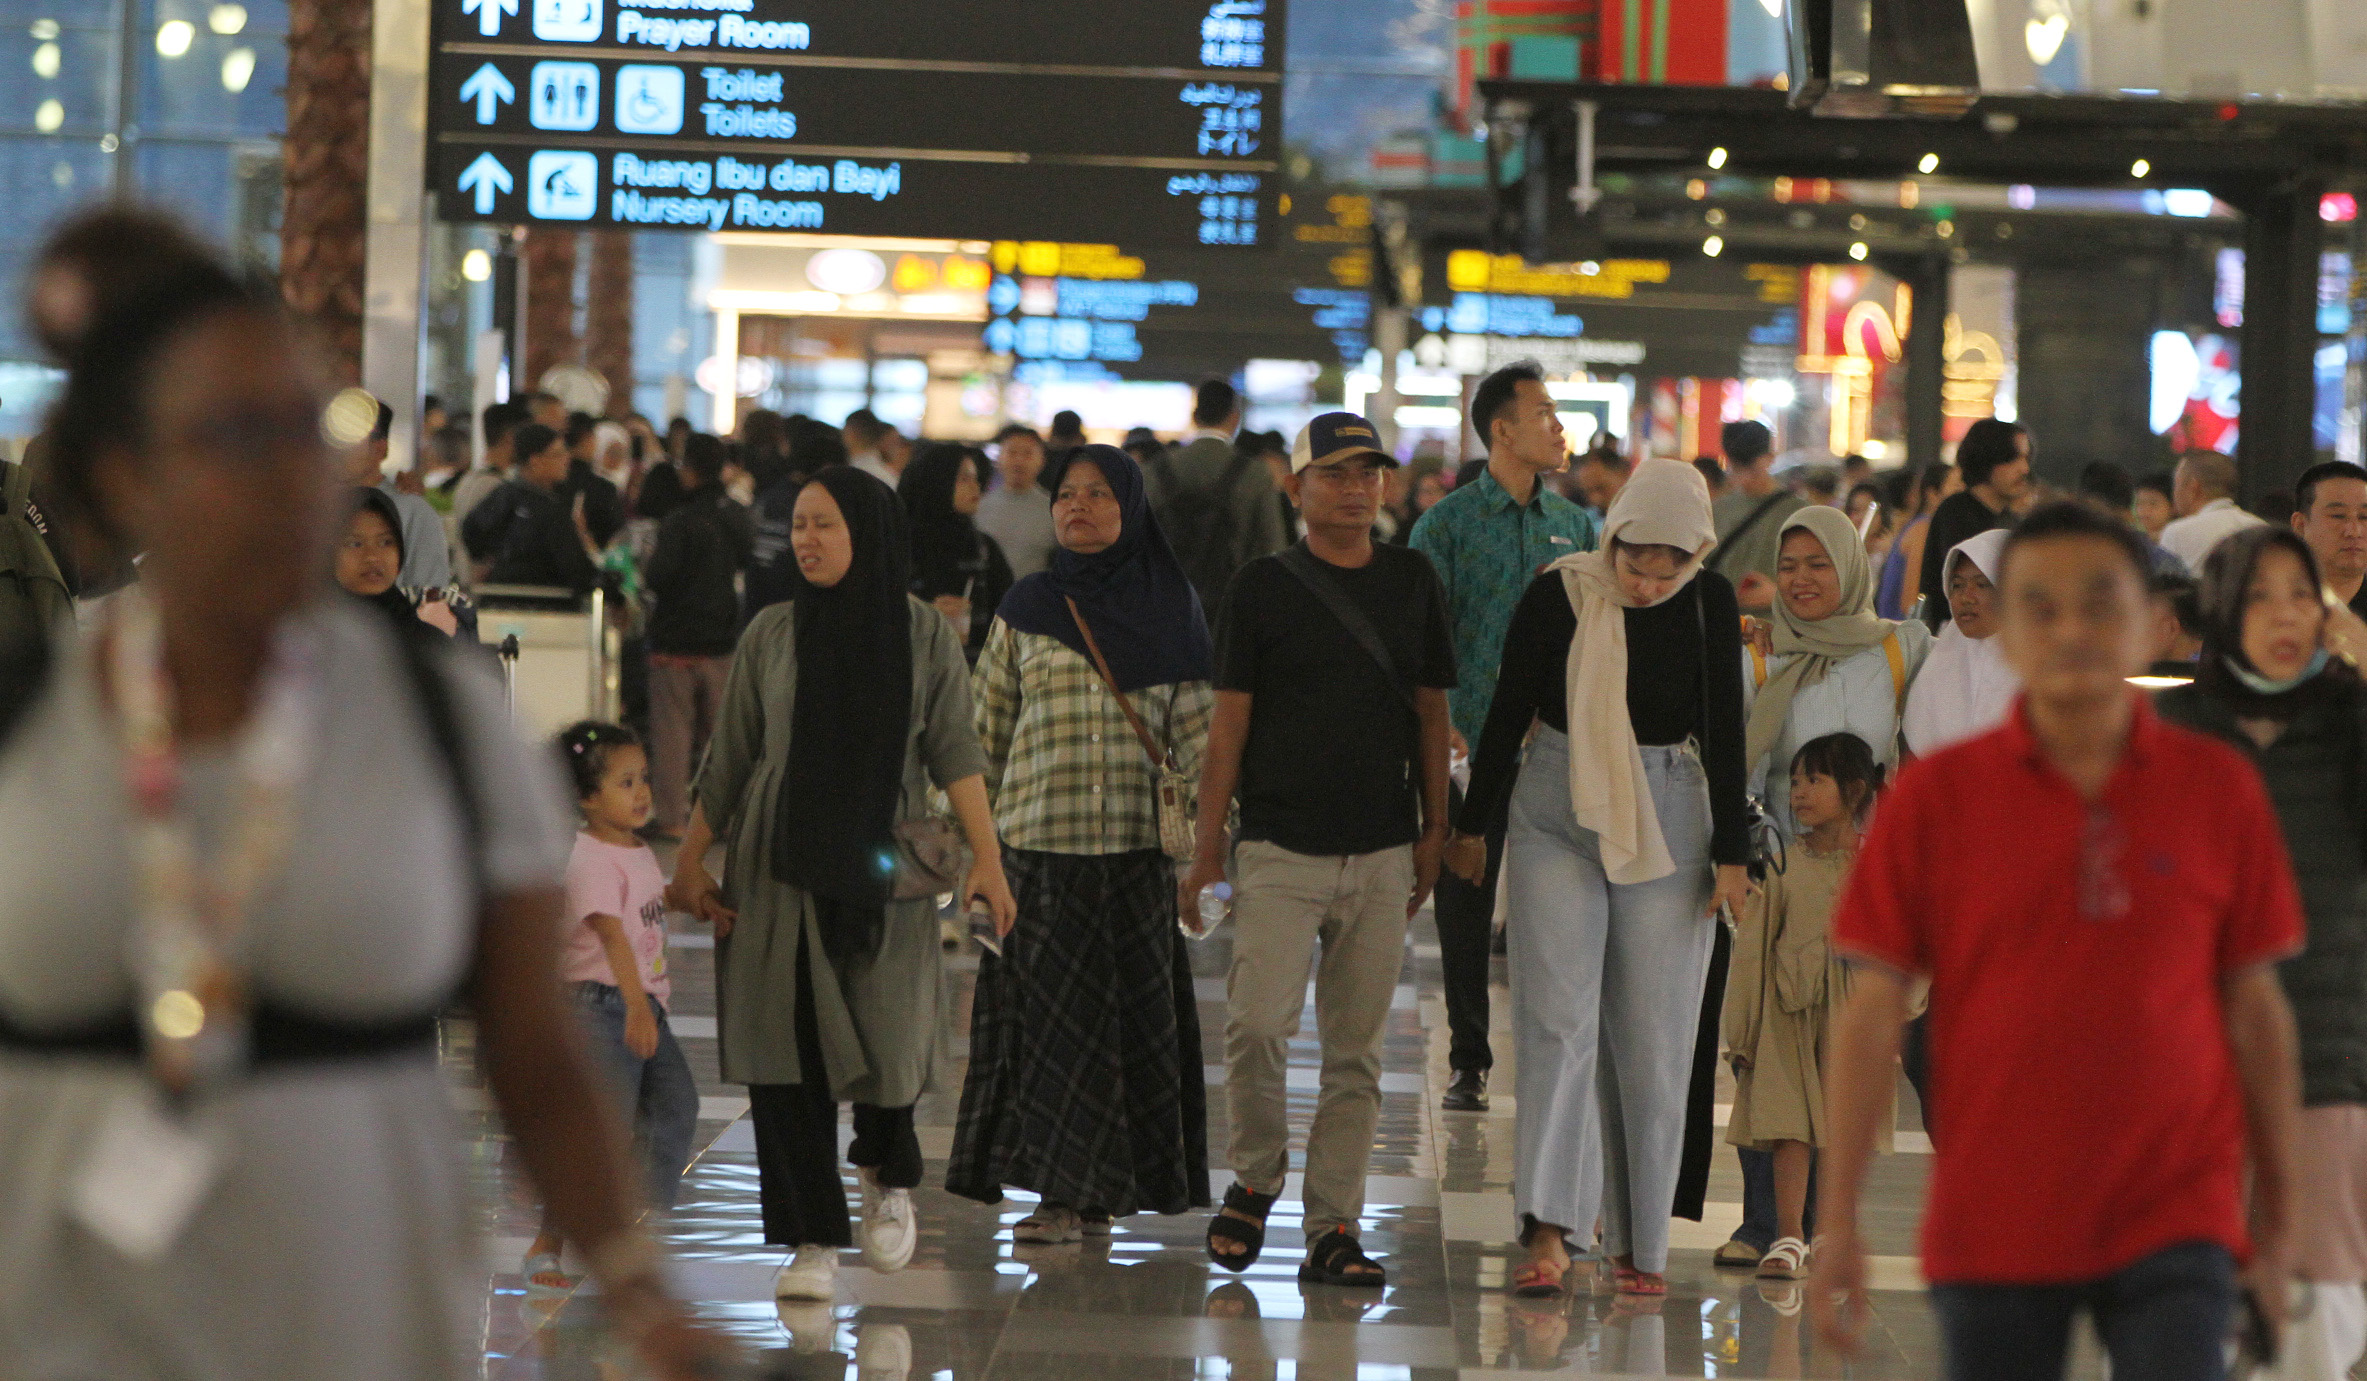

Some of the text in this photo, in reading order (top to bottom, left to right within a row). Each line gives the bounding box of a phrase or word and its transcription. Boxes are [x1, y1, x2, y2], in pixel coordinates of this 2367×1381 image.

[616, 10, 810, 52] Prayer Room
[700, 66, 784, 102] Toilet
[699, 102, 797, 139] Toilets
[612, 152, 900, 201] Ruang Ibu dan Bayi
[612, 188, 823, 232] Nursery Room
